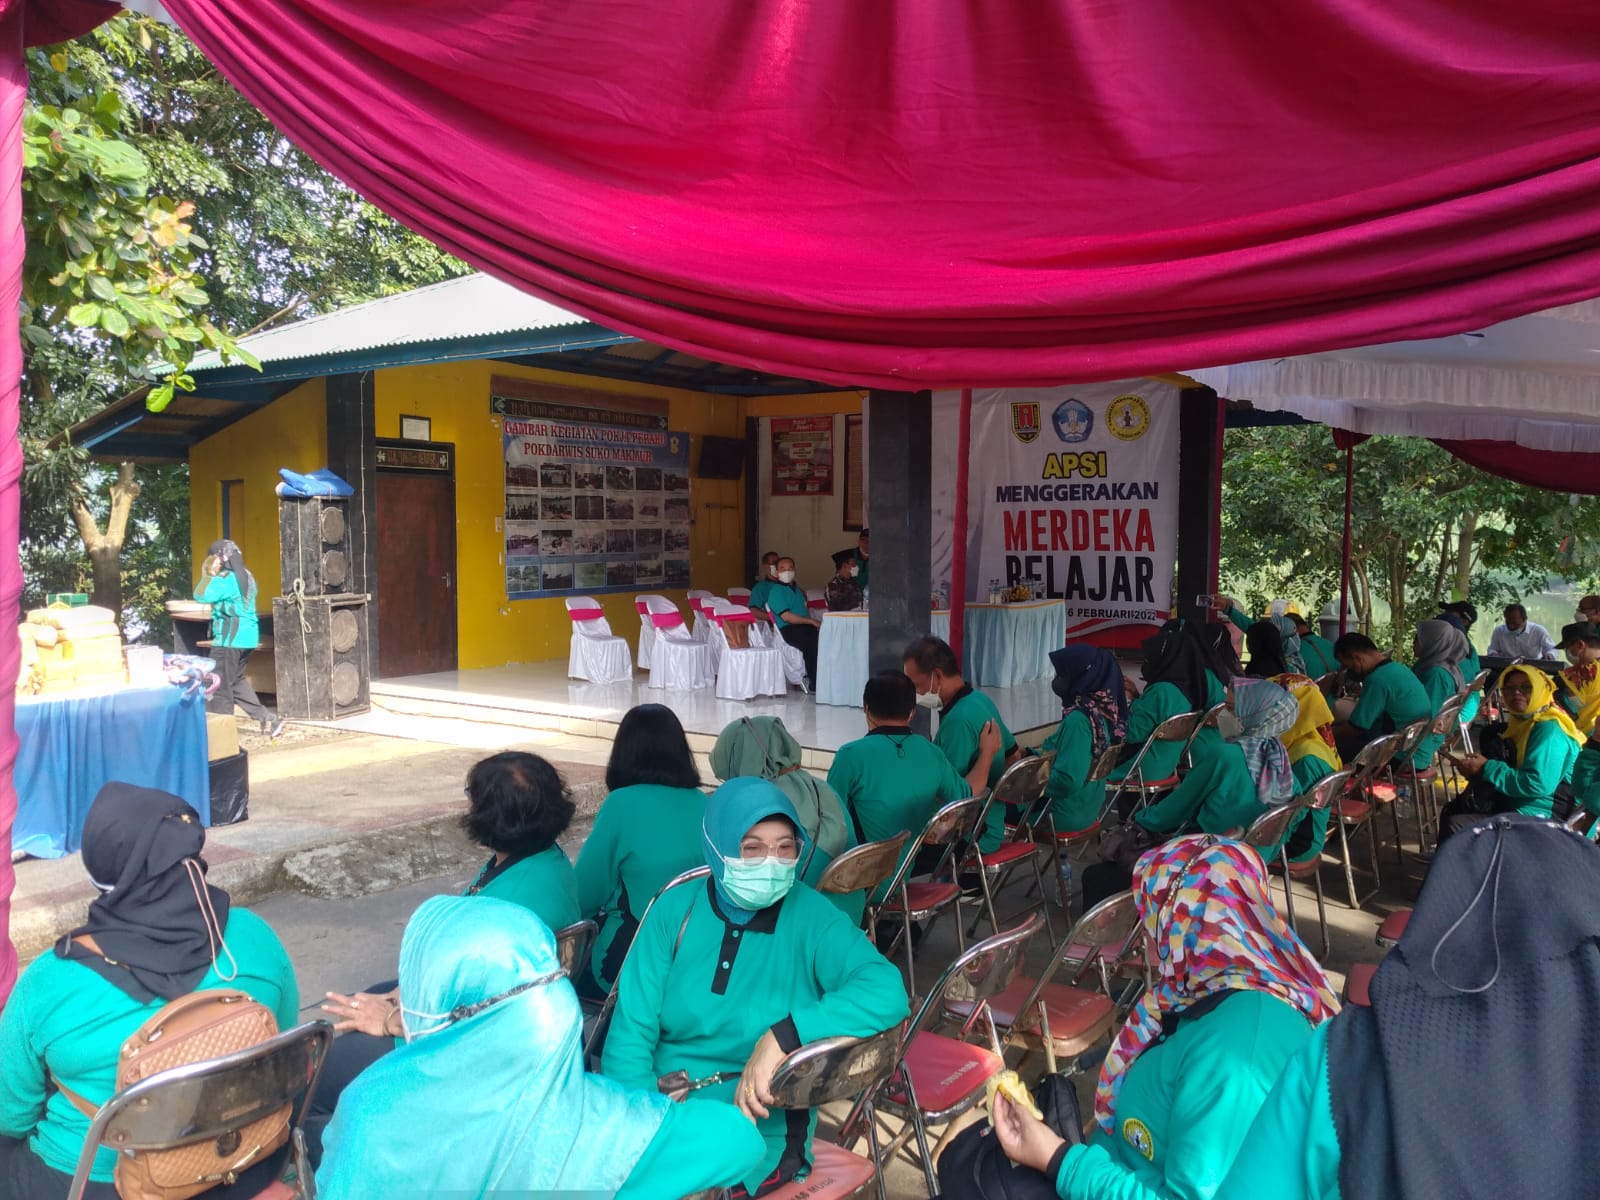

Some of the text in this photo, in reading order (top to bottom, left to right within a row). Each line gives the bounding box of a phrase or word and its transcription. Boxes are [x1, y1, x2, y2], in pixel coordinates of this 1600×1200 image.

[505, 421, 666, 446] GAMBAR KEGIATAN POKJA PERAHU
[524, 442, 652, 461] POKDARWIS SUKO MAKMUR
[1042, 451, 1107, 479] APSI
[996, 482, 1159, 503] MENGGERAKAN
[1003, 508, 1156, 552] MERDEKA
[1005, 555, 1155, 603] BELAJAR
